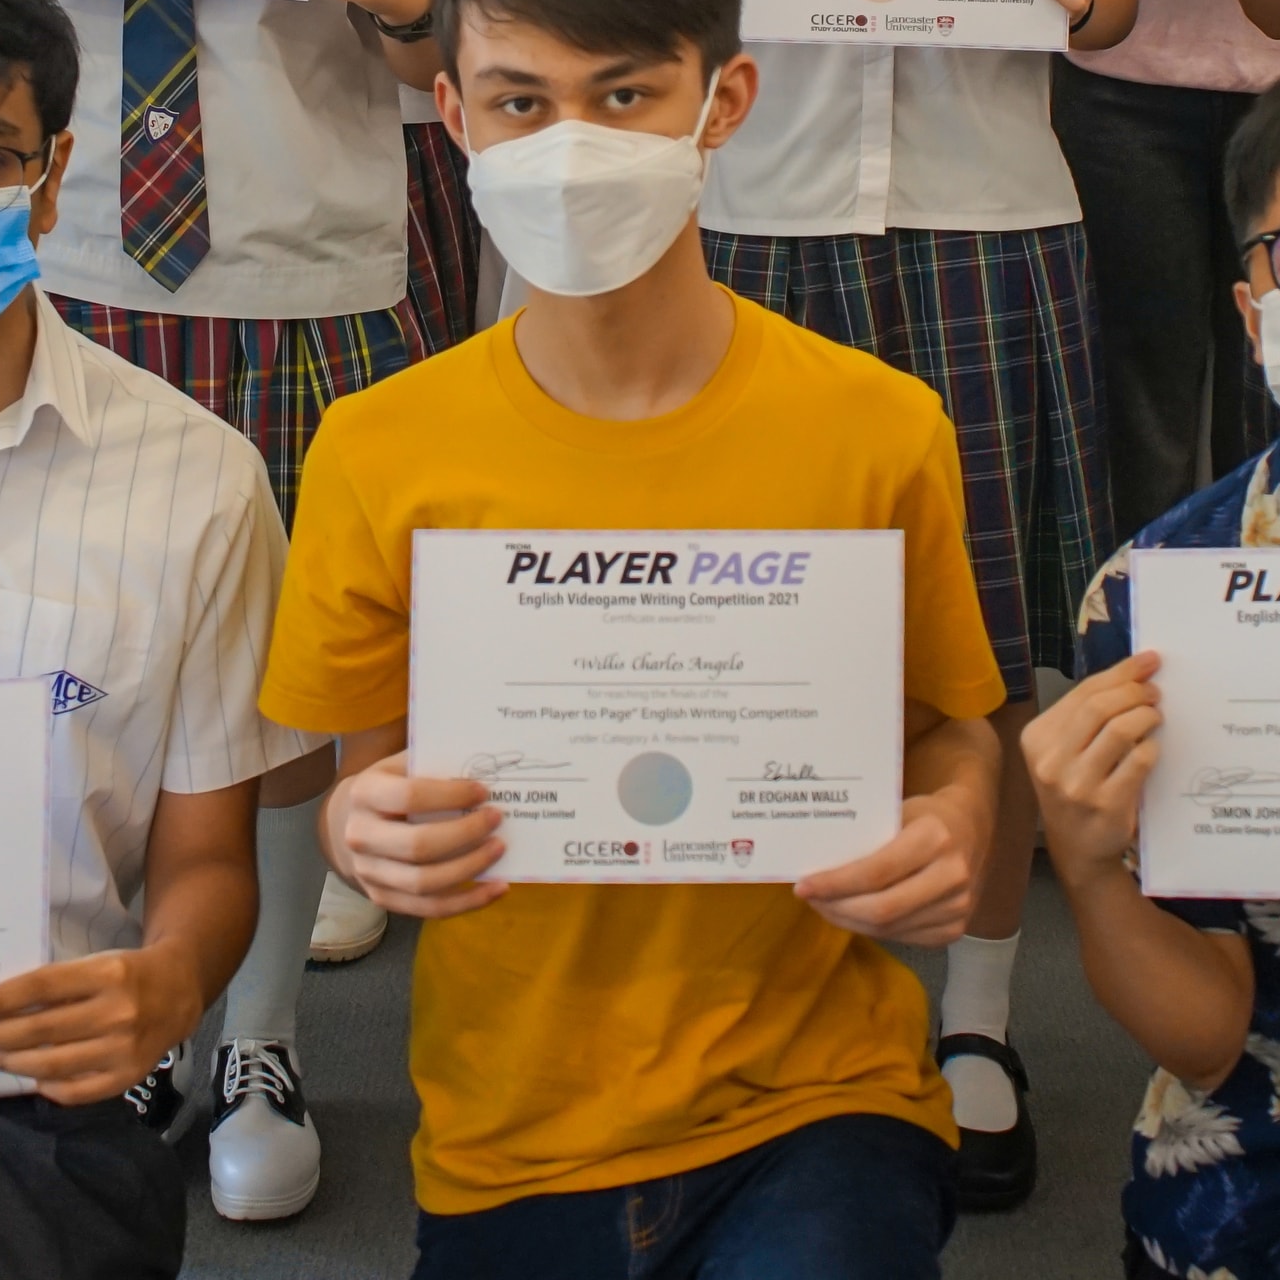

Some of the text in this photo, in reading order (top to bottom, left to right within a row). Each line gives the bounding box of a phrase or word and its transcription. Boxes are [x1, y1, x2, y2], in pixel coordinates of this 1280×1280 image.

[811, 14, 868, 26] CICERO
[507, 551, 811, 585] PLAYER PAGE
[519, 592, 798, 609] English Videogame Writing Competition 2021
